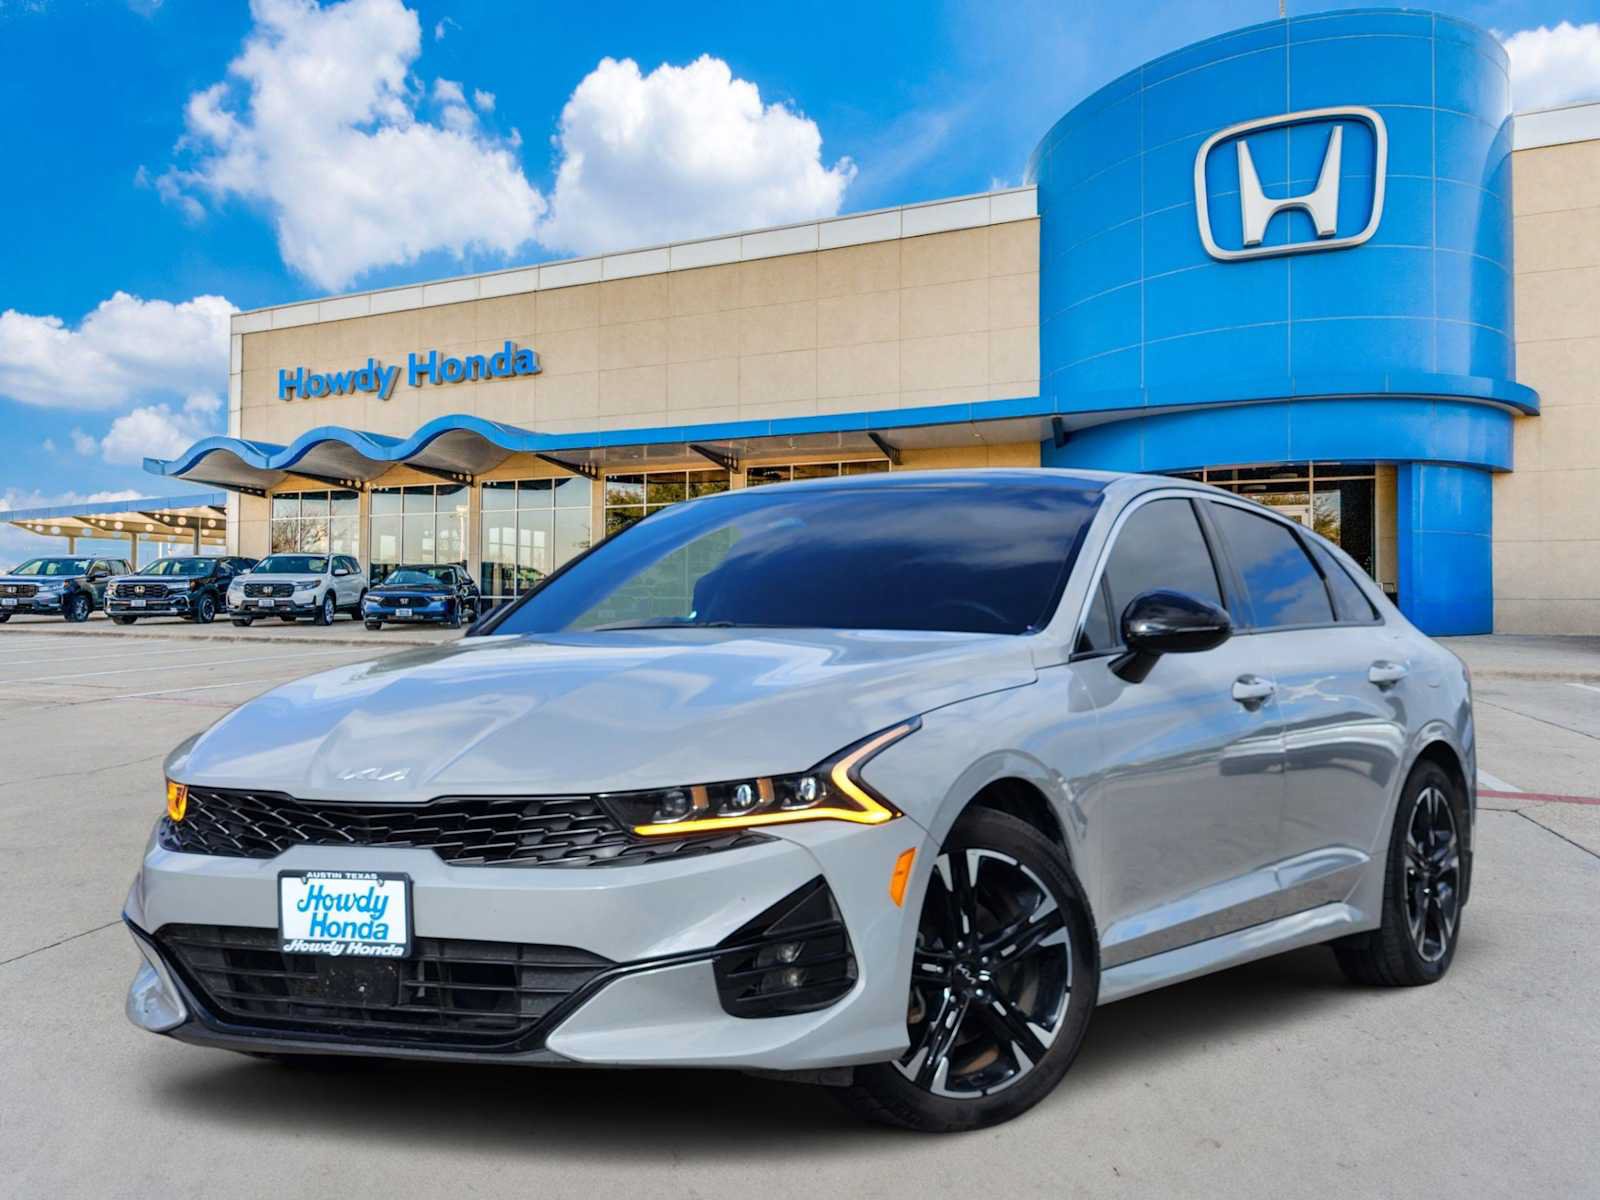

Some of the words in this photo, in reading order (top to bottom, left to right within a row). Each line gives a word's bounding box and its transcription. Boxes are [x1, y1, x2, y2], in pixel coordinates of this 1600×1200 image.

[278, 357, 400, 401] Howdy
[407, 340, 542, 387] Honda
[306, 871, 342, 879] AUSTIN
[345, 872, 378, 880] TEXAS
[297, 884, 389, 920] Howdy
[309, 912, 389, 940] Honda
[283, 939, 345, 956] Howdy
[346, 941, 405, 957] Honda
